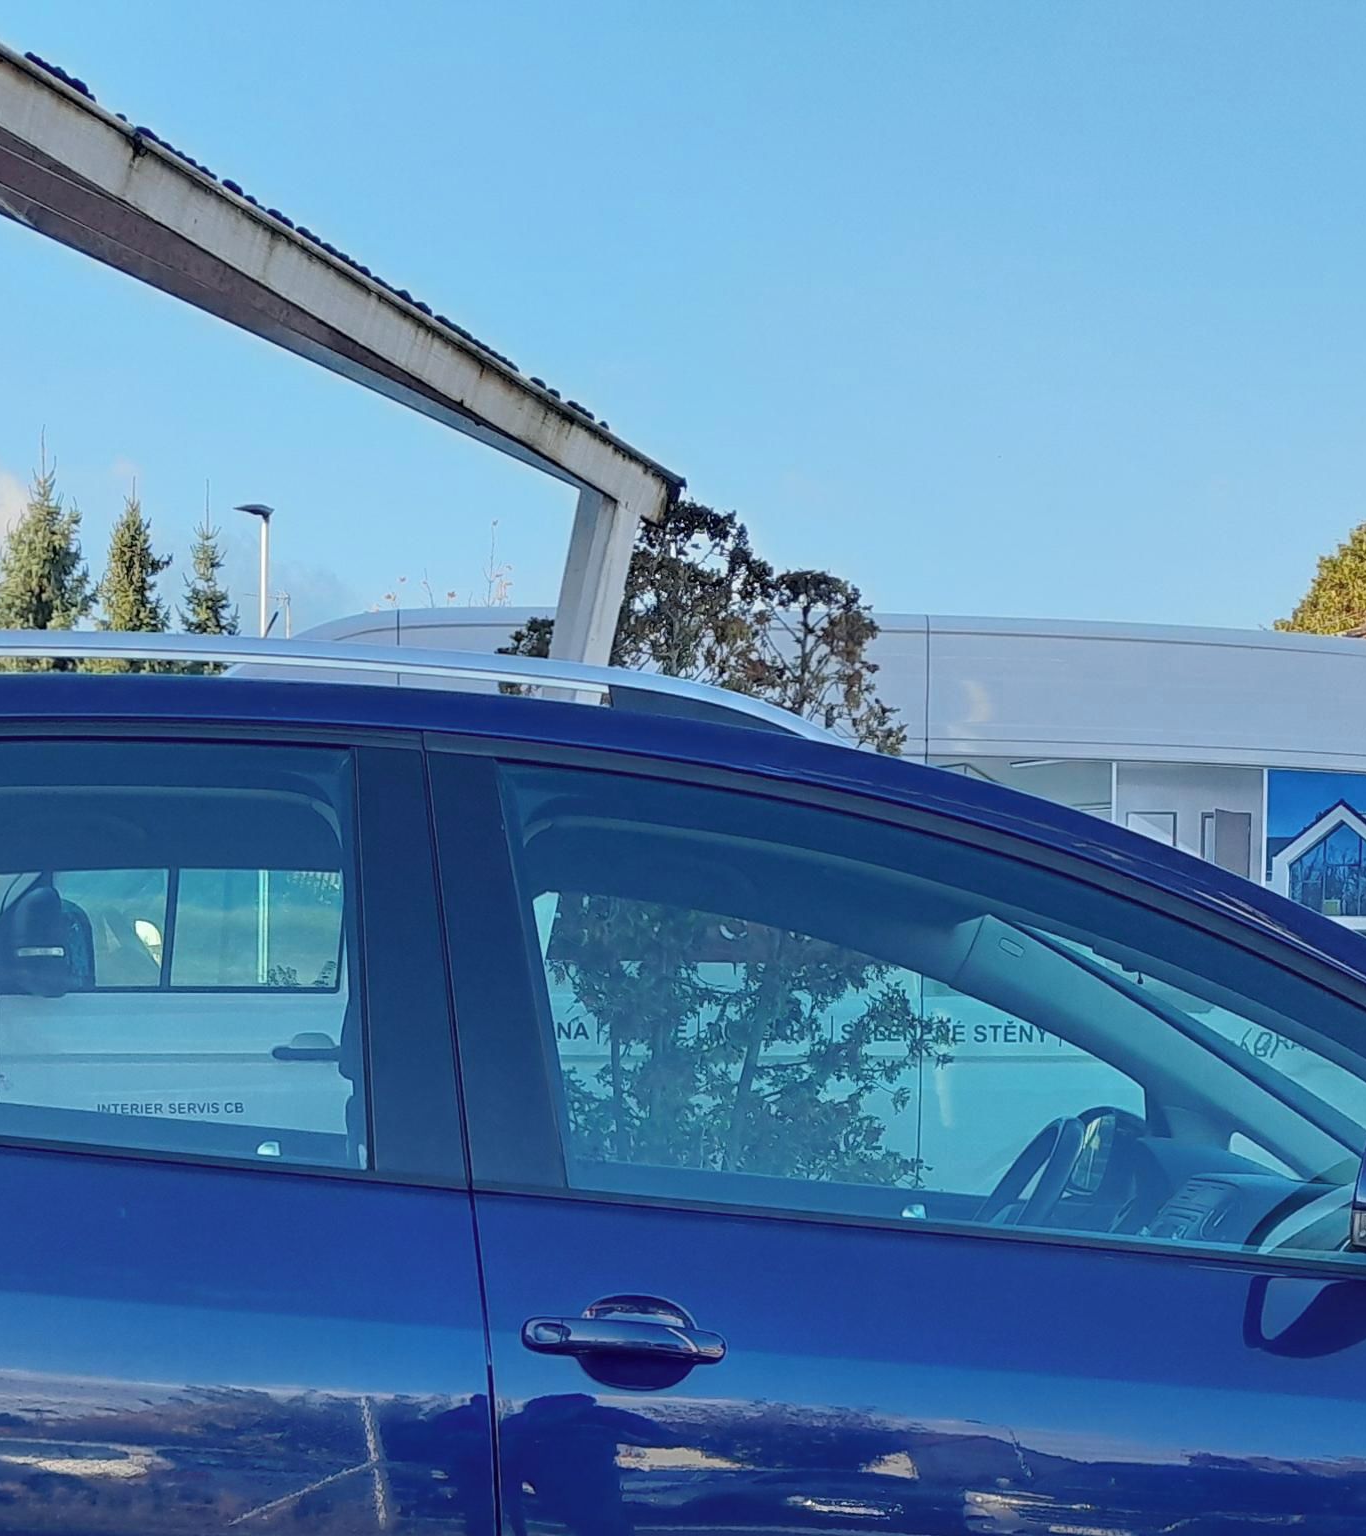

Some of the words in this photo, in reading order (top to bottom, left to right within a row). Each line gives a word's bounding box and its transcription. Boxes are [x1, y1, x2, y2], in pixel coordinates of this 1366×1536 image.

[973, 1019, 1046, 1043] STĚNY
[97, 1103, 163, 1115] INTERIER
[168, 1102, 220, 1114] SERVIS
[224, 1102, 244, 1114] CB
